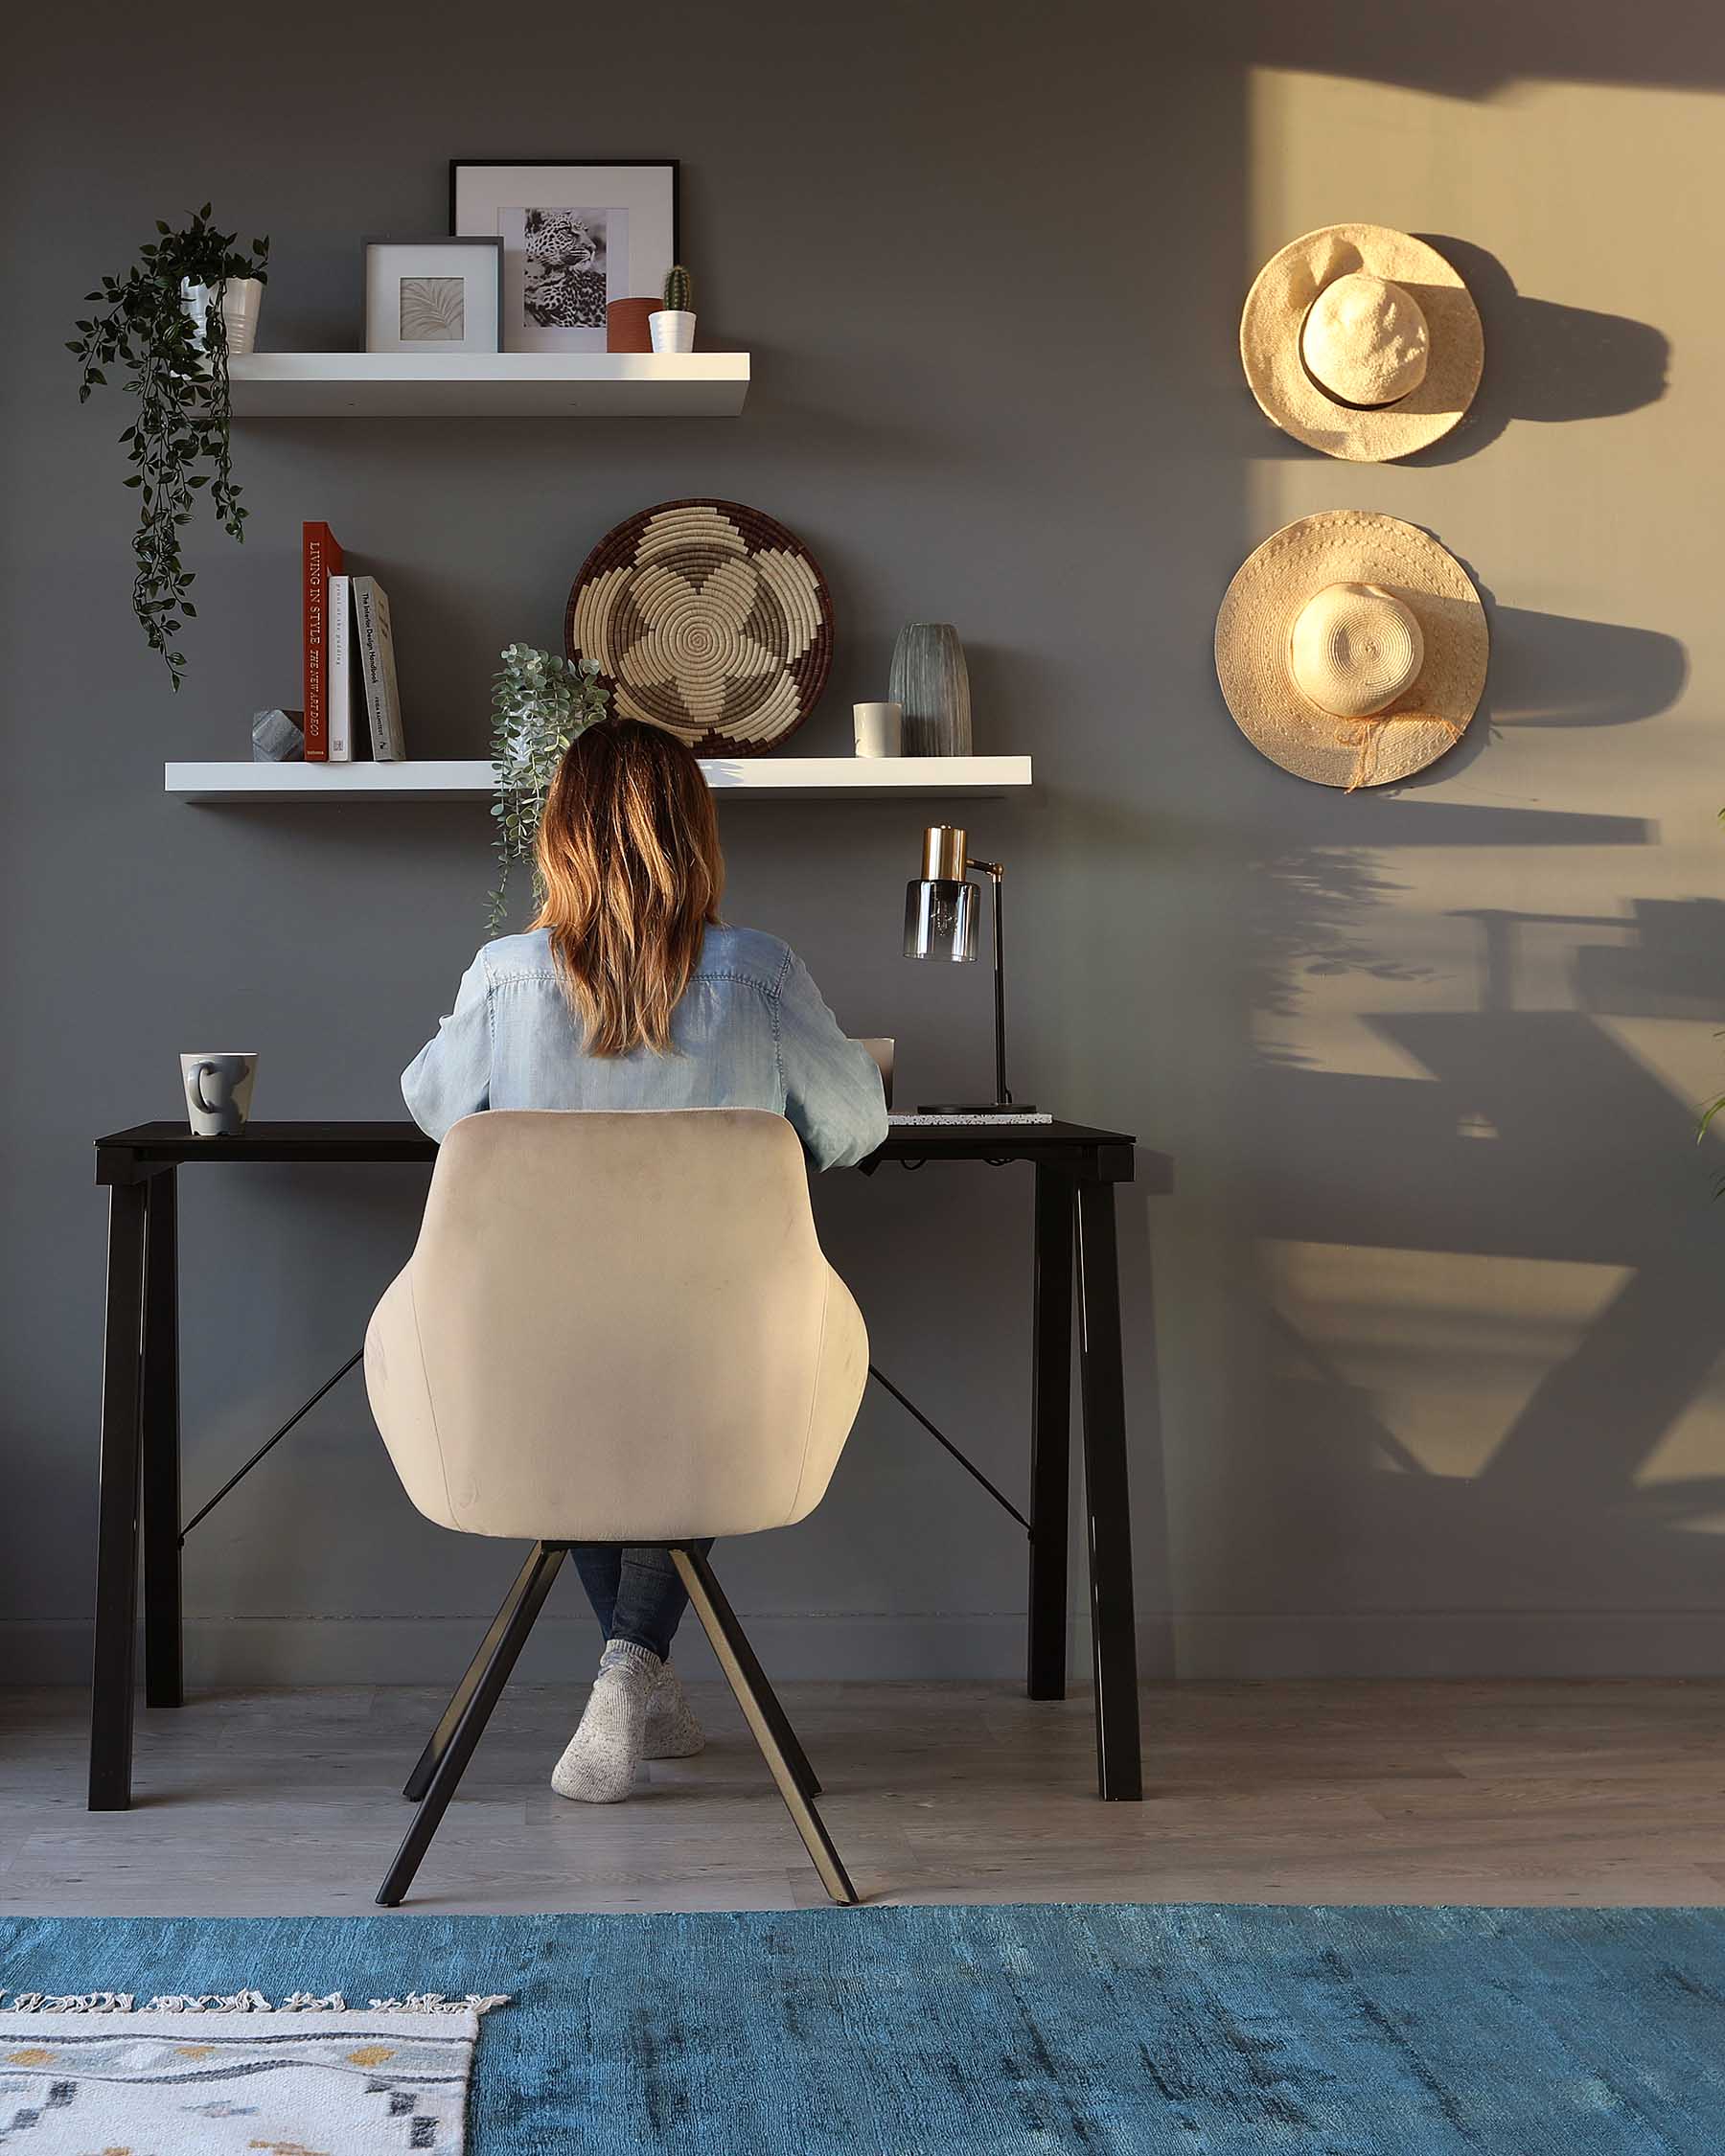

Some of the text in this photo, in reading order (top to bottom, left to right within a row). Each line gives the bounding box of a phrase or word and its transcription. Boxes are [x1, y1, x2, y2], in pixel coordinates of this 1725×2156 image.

[310, 541, 320, 645] LIVING IN STYLE
[363, 606, 372, 628] Interior
[369, 651, 379, 684] Handbook
[310, 650, 319, 737] THE NEW ART DECO
